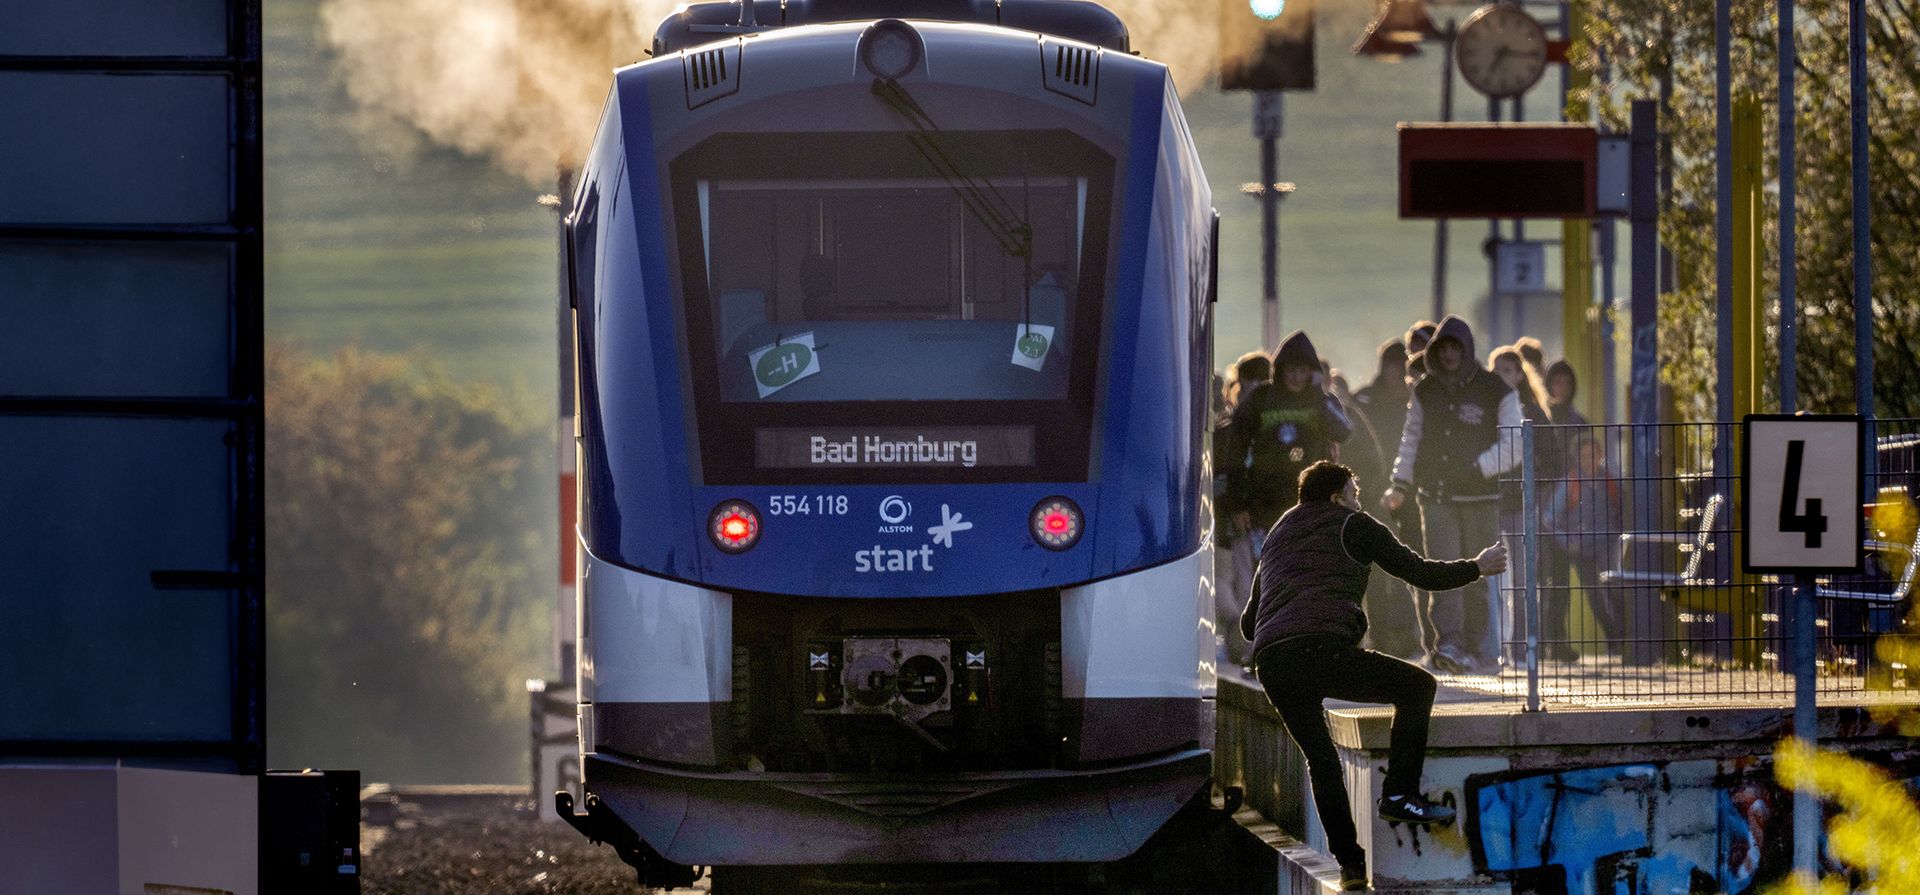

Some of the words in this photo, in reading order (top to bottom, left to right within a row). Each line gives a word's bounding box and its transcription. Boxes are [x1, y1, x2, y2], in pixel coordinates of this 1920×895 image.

[810, 436, 858, 463] Bad
[864, 435, 977, 468] Homburg
[769, 495, 810, 515] 554
[816, 495, 848, 515] 118
[1779, 440, 1828, 548] 4
[878, 525, 913, 533] ALSTOM
[855, 544, 934, 572] start
[1403, 802, 1424, 816] FILA
